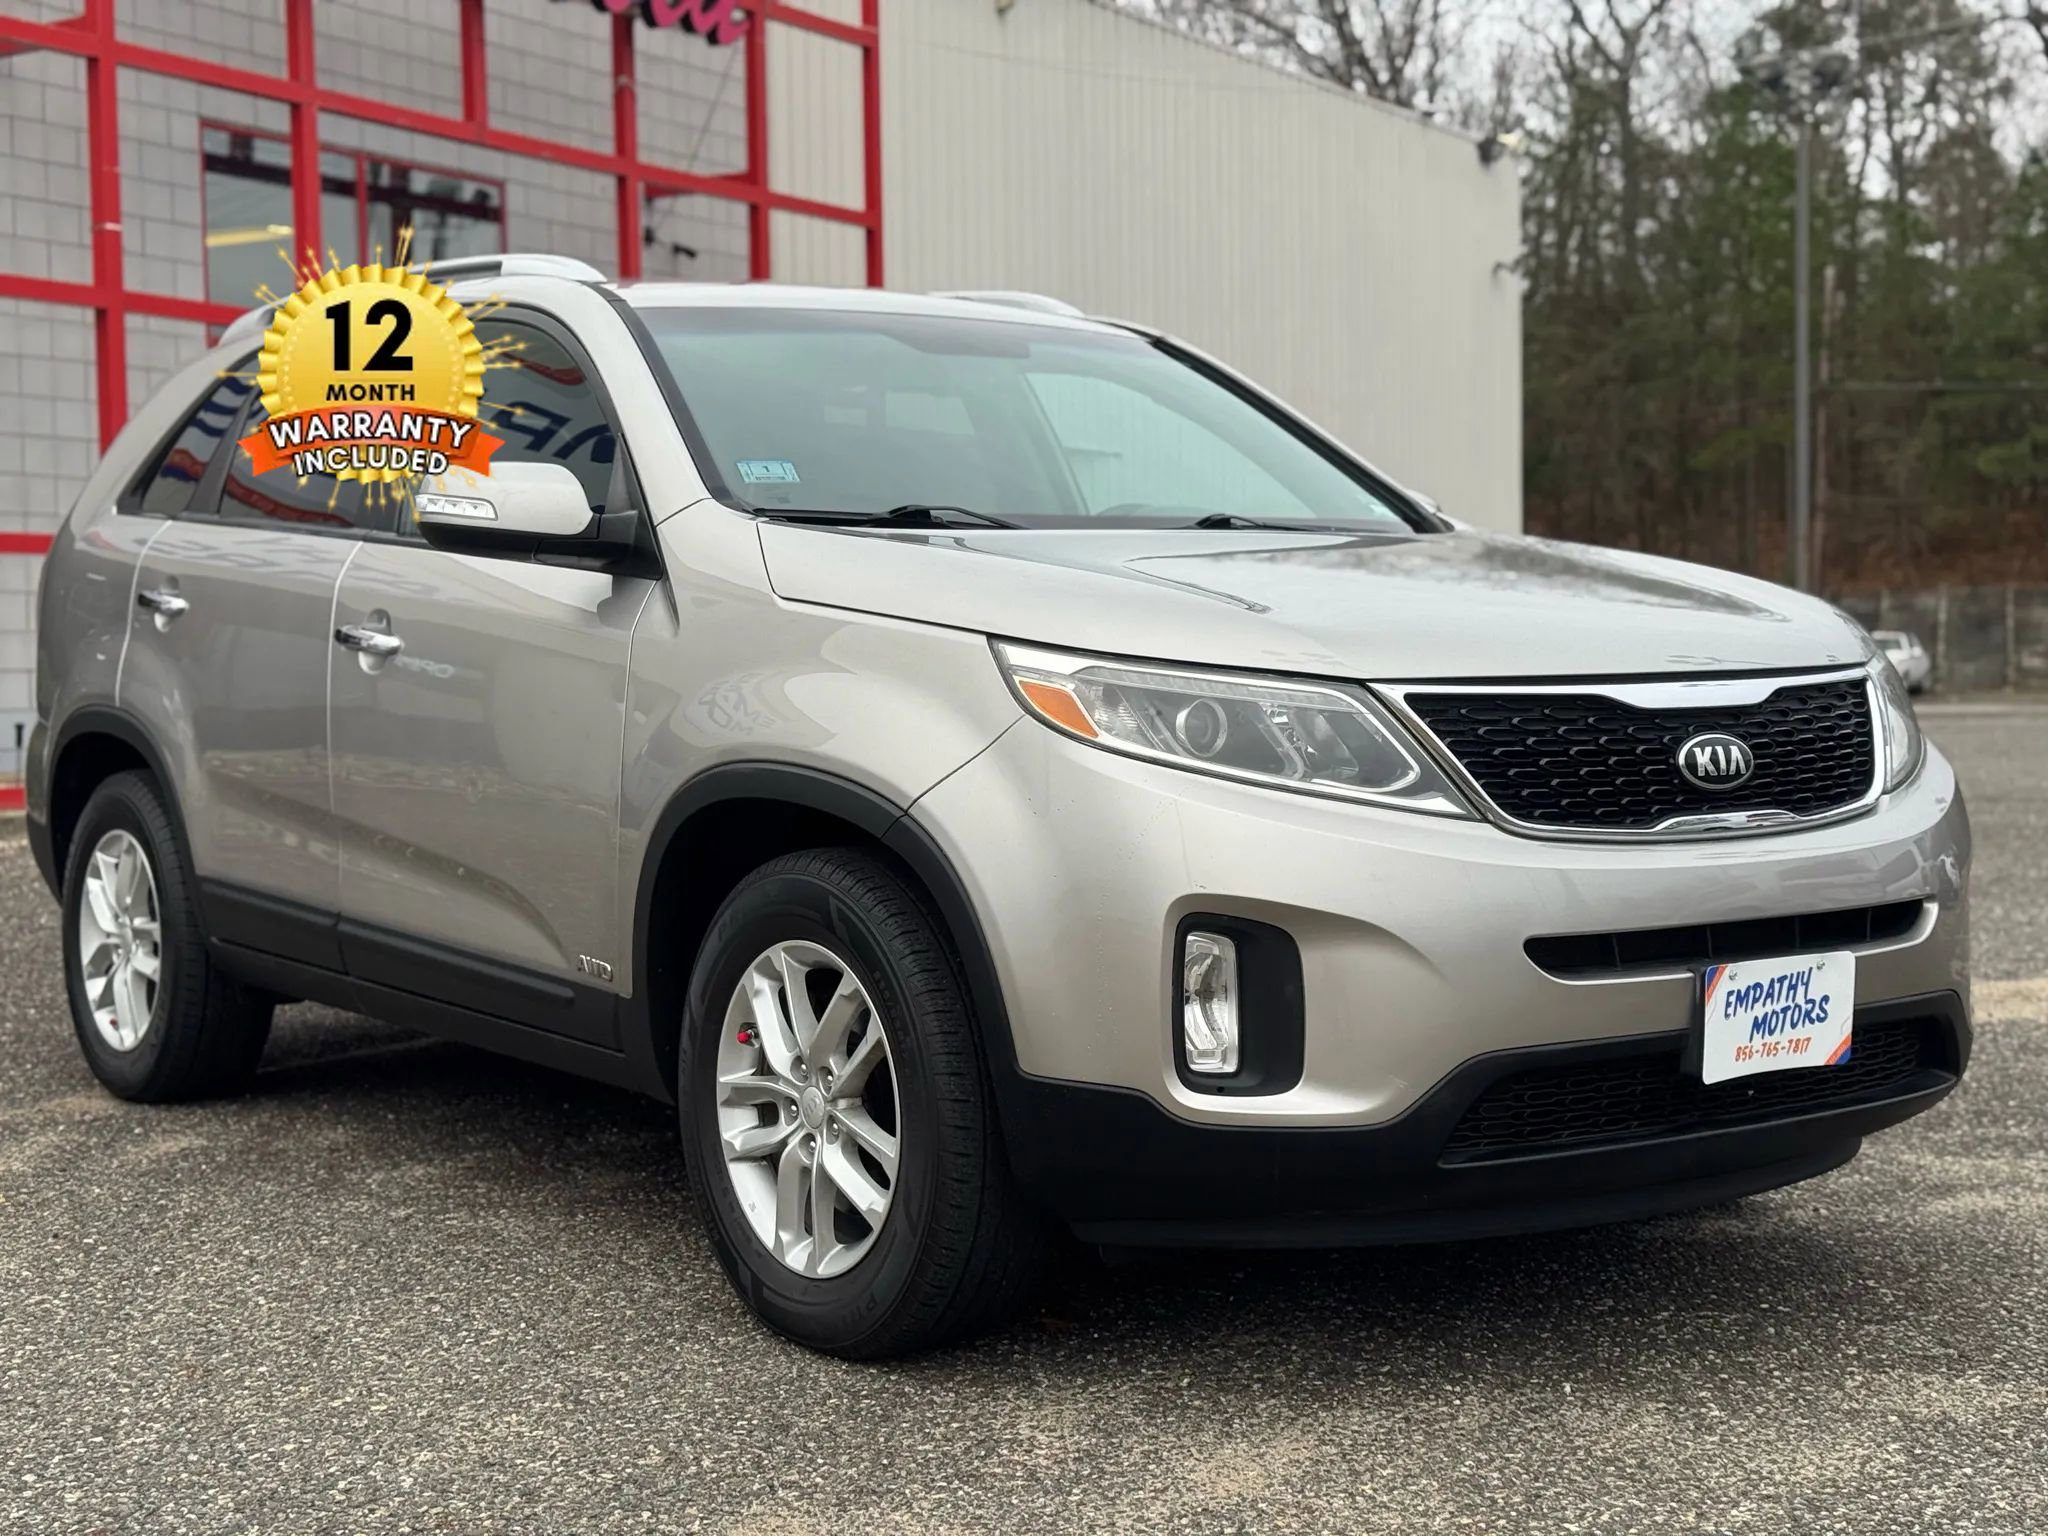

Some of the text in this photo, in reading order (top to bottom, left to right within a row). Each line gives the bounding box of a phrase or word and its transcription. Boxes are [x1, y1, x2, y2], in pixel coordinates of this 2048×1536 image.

[1692, 745, 1747, 777] KIA
[1724, 967, 1813, 1020] EMPATHY
[1749, 994, 1830, 1043] MOTORS
[1735, 1037, 1812, 1063] 856-765-7817
